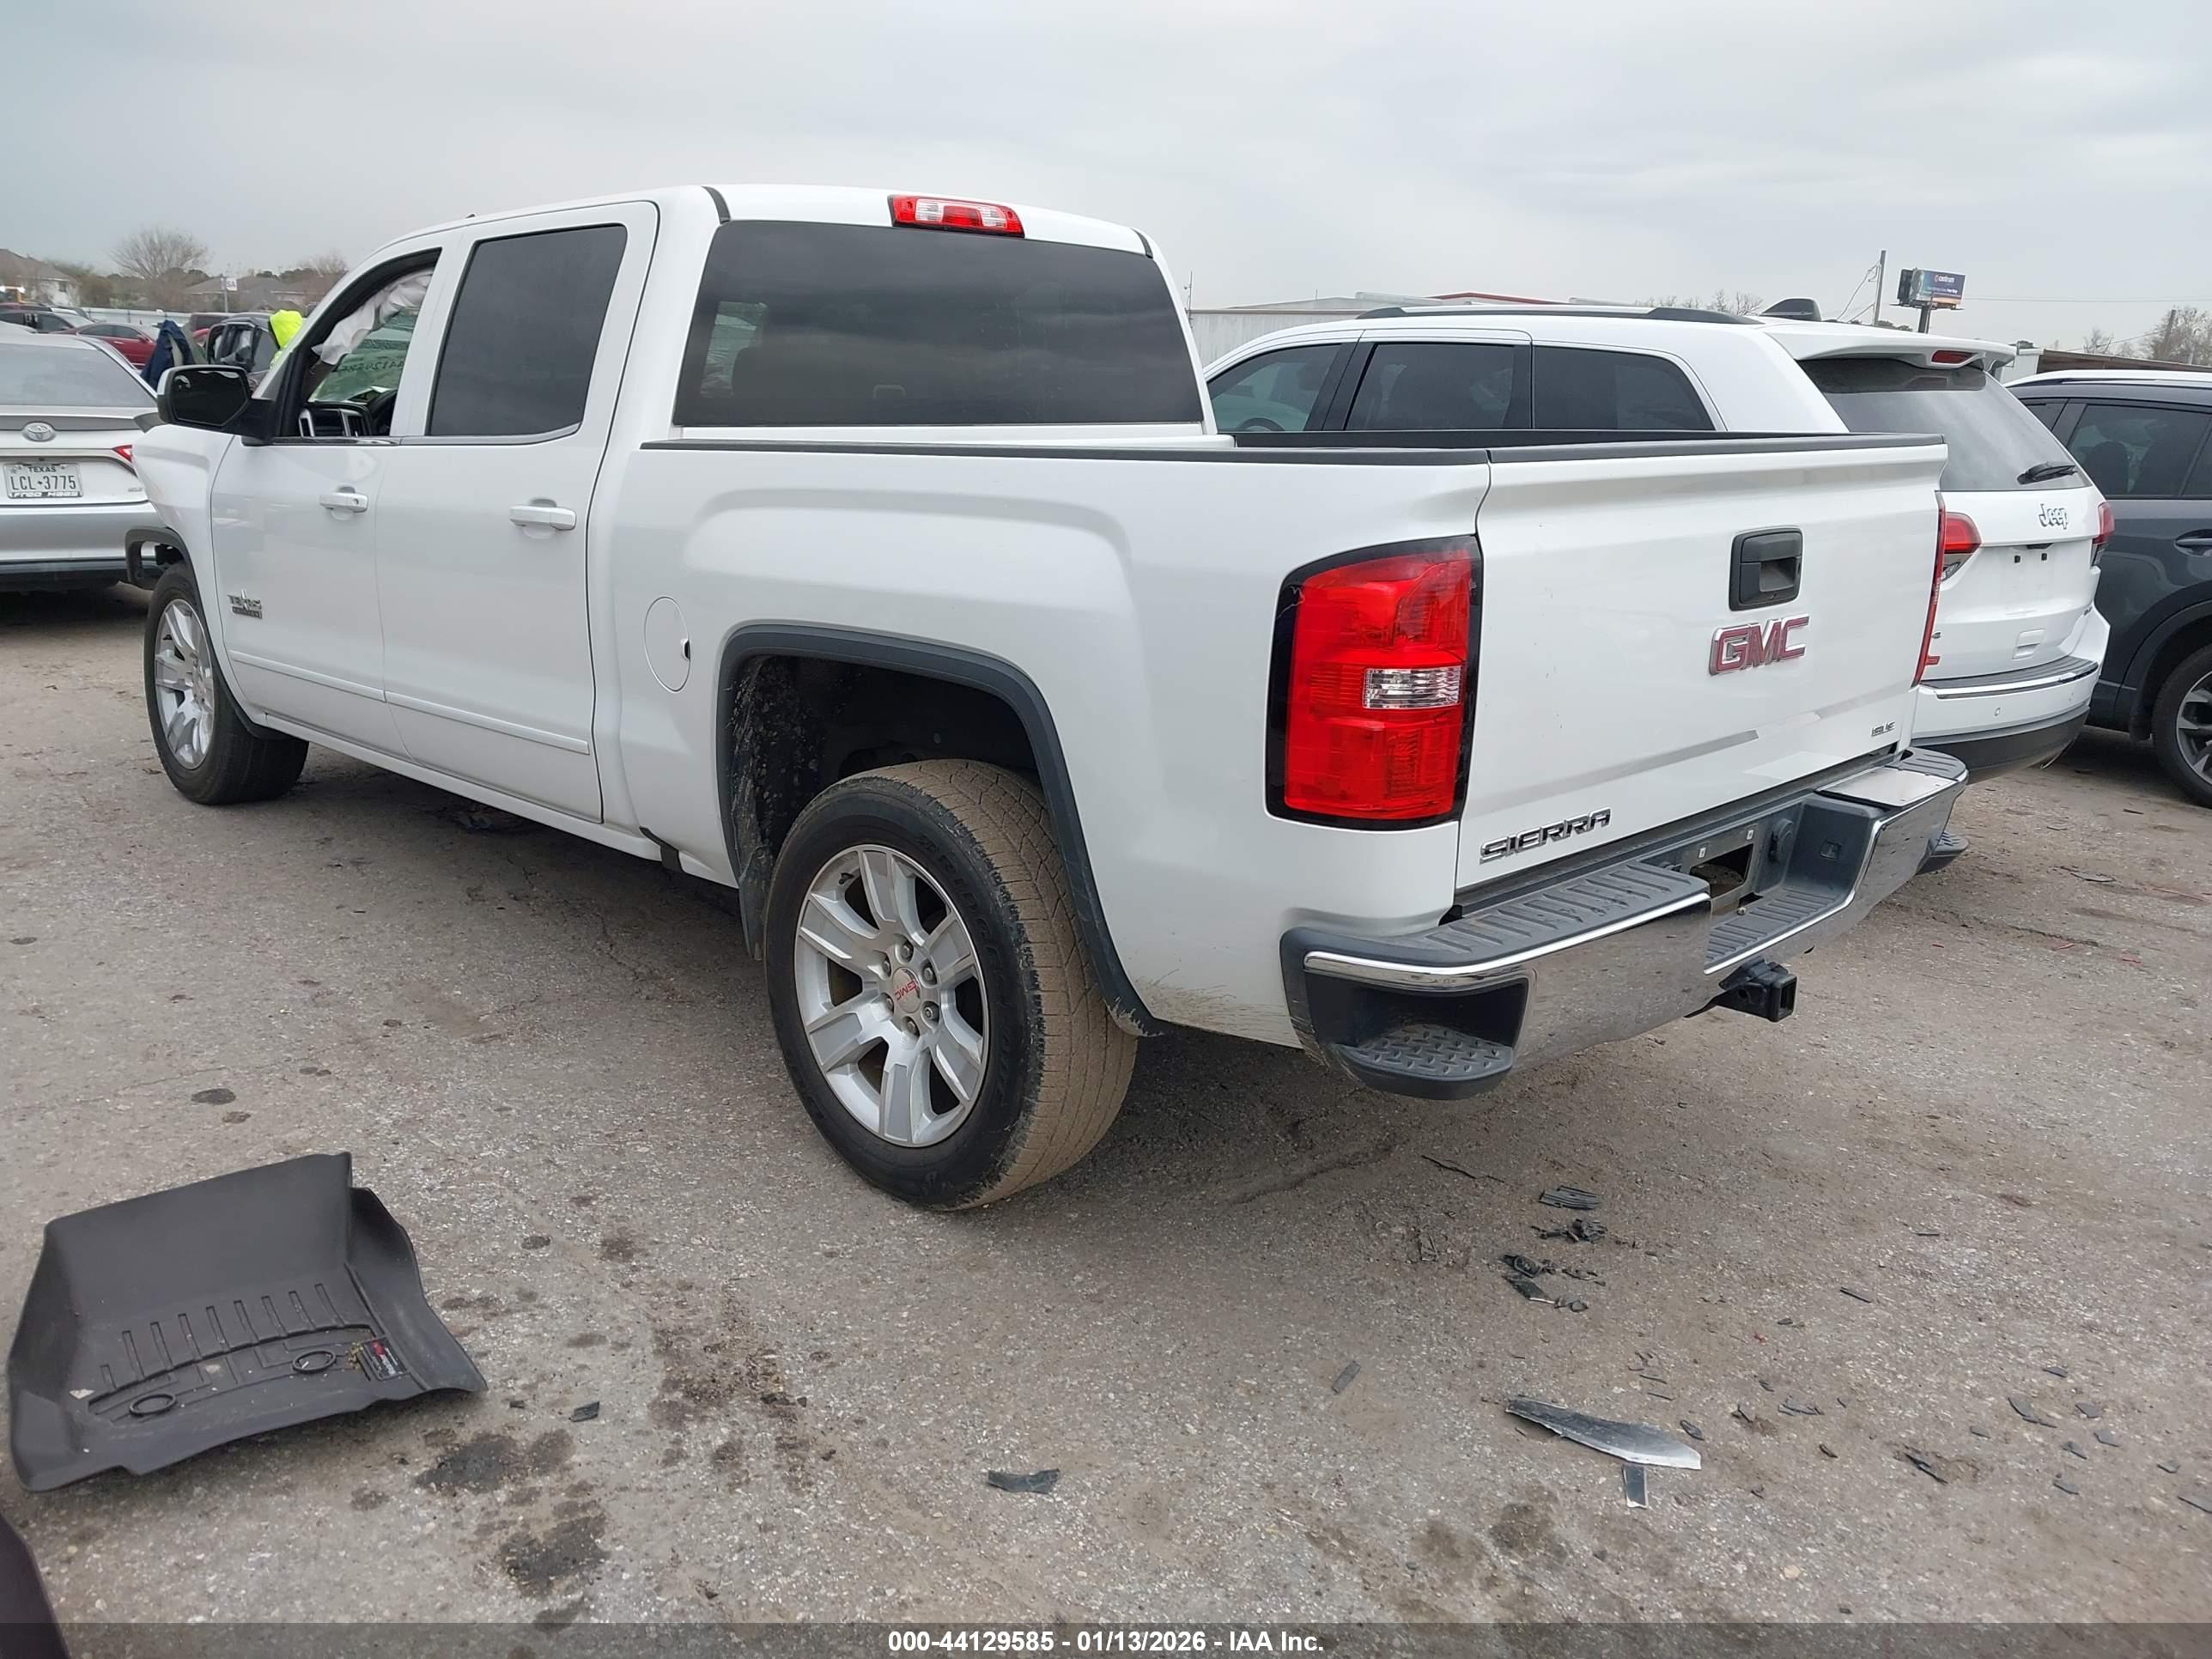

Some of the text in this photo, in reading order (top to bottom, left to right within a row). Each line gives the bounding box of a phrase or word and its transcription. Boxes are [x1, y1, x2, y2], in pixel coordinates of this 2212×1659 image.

[2039, 503, 2069, 530] Jeep
[1709, 613, 1809, 675] GMC
[1480, 806, 1612, 865] SIERRA
[894, 981, 917, 1001] GMC
